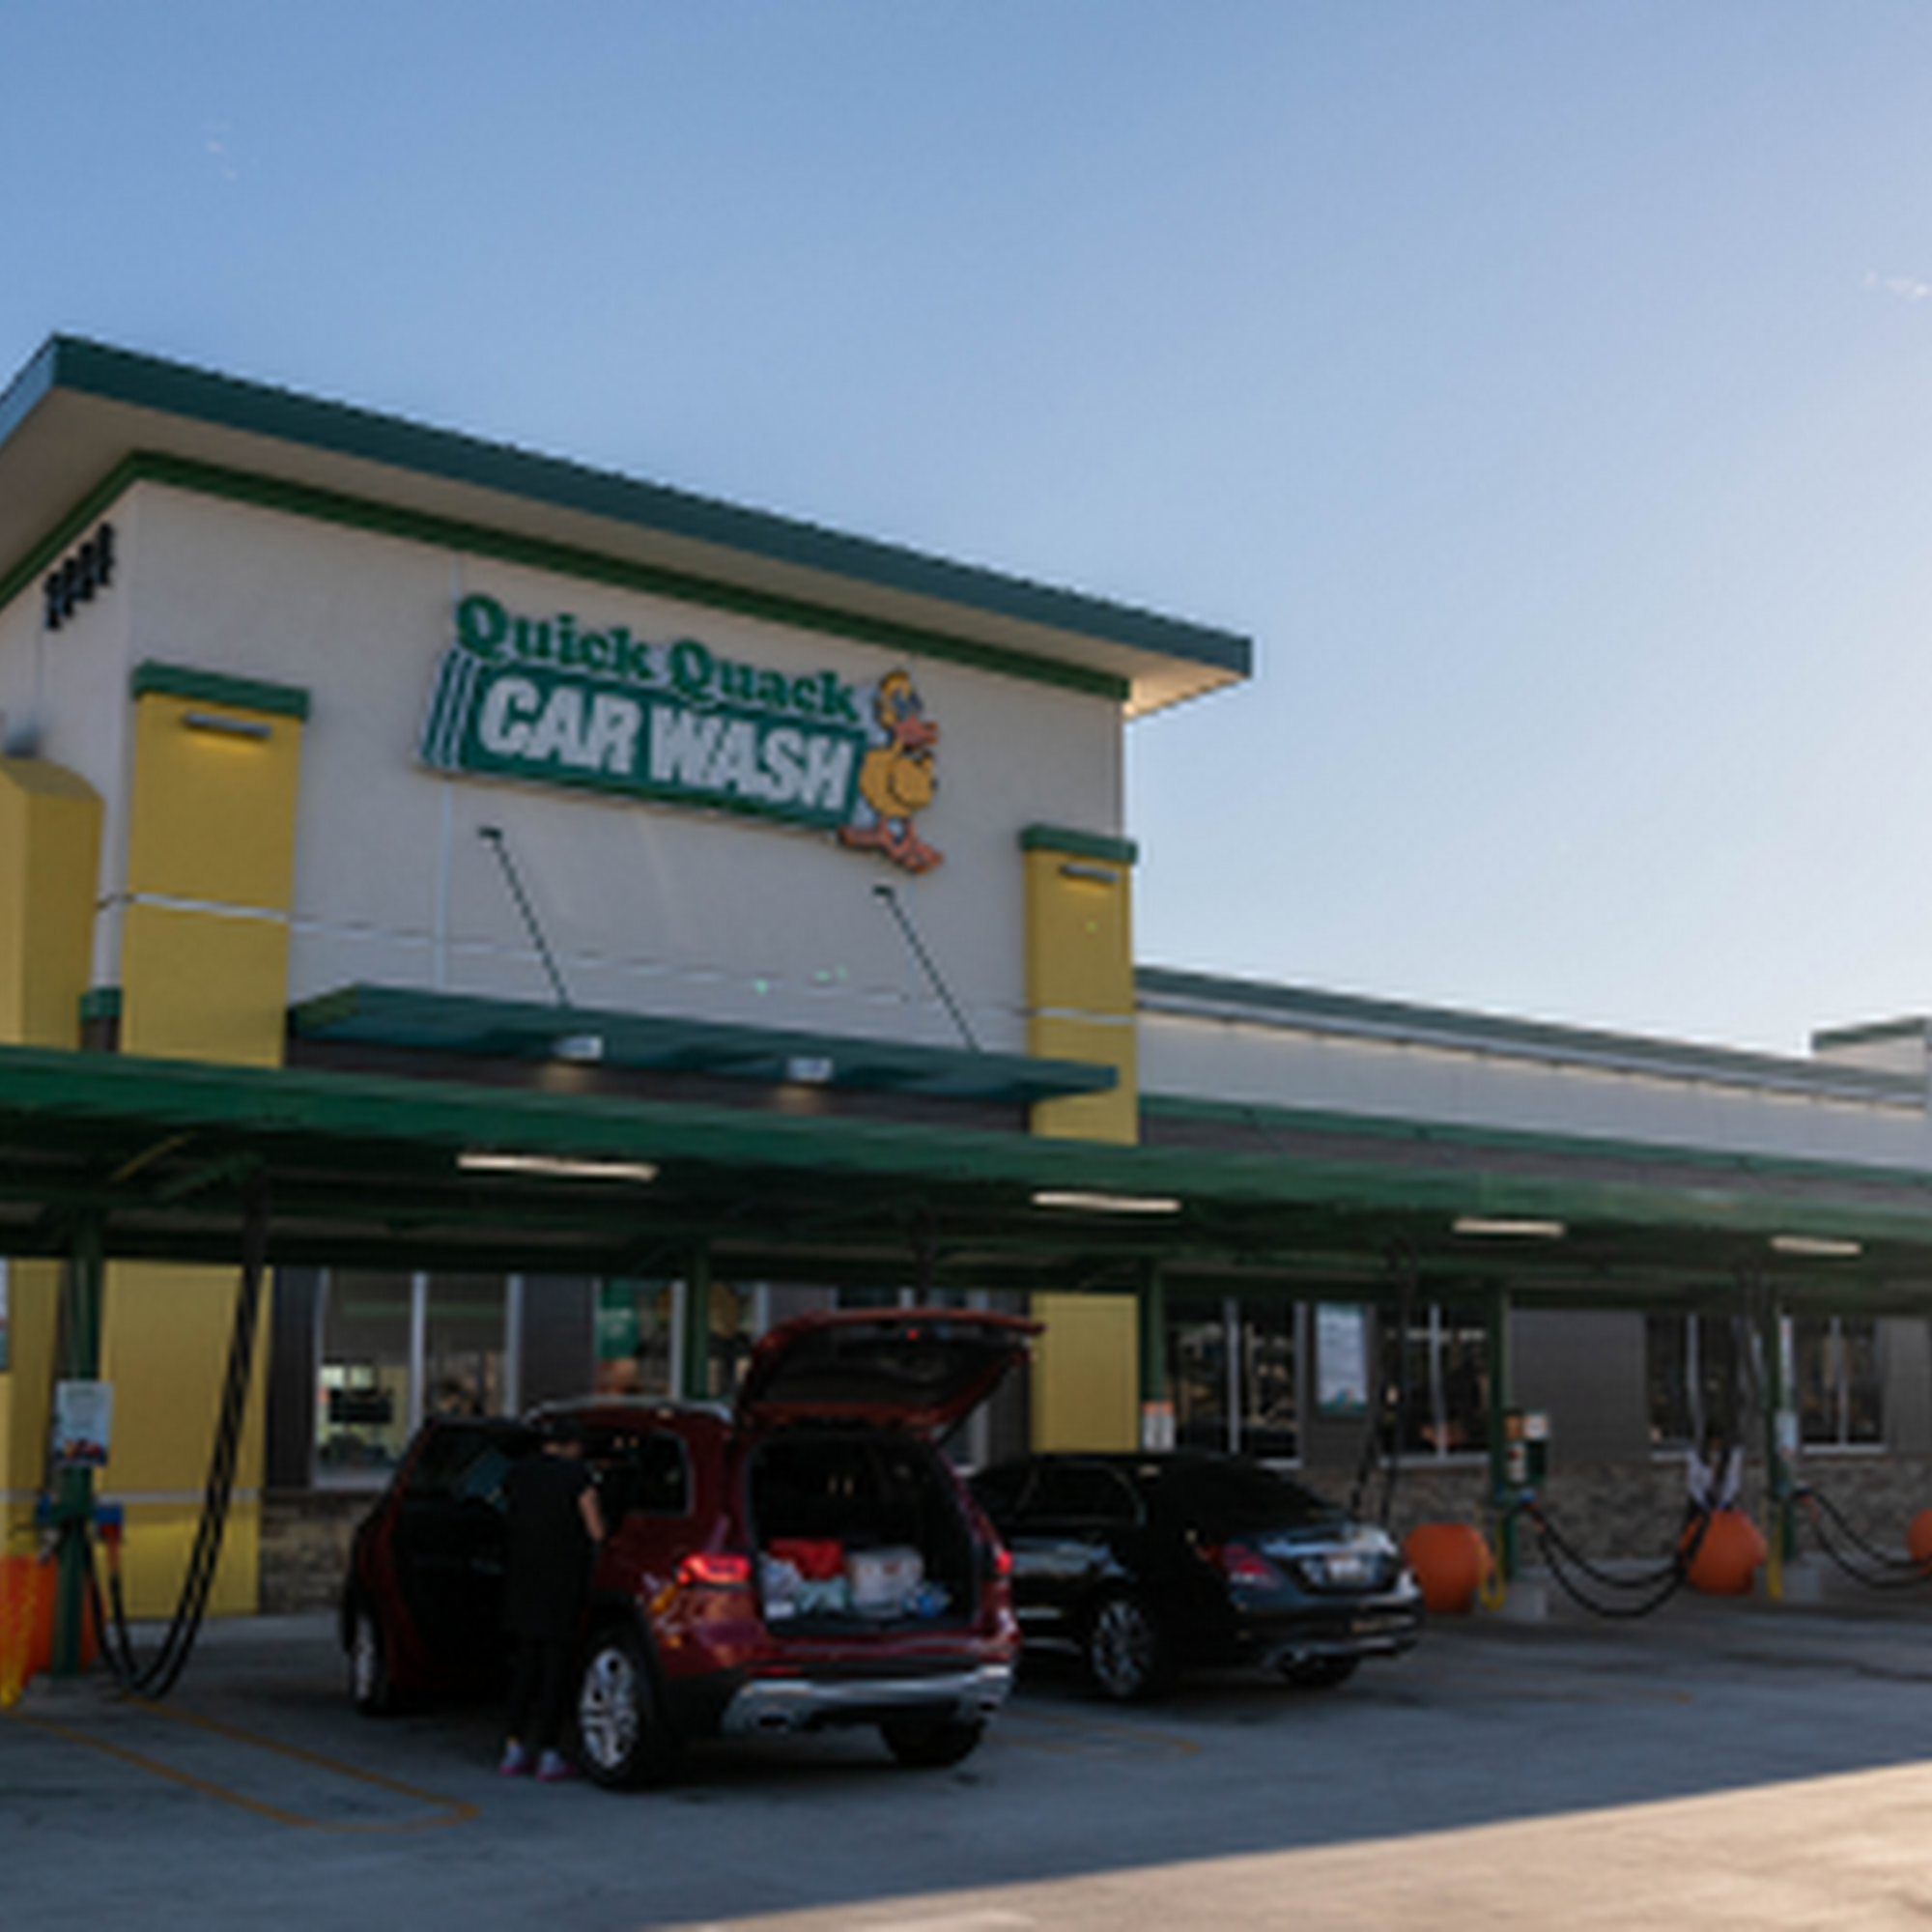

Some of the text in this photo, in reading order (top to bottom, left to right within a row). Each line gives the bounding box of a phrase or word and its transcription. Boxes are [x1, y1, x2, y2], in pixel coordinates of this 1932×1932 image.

[456, 594, 859, 721] Quick Quack
[480, 679, 854, 810] CAR WASH
